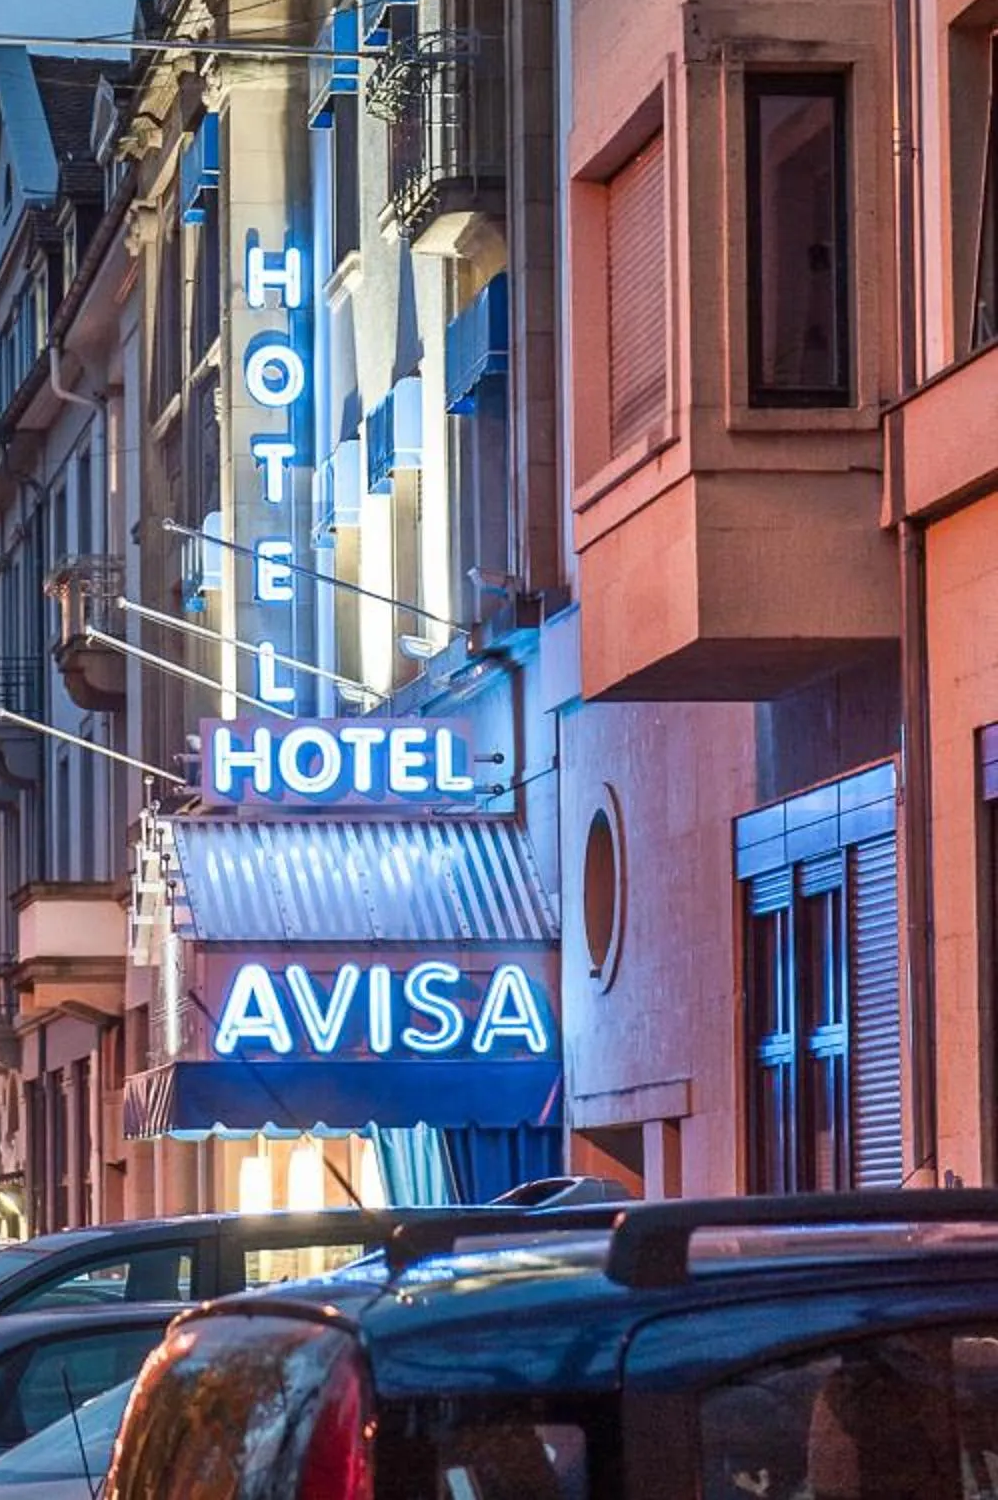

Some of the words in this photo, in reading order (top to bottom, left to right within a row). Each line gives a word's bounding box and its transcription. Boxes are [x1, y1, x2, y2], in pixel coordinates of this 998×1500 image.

[245, 246, 304, 702] HOTEL
[214, 726, 475, 793] HOTEL
[214, 961, 549, 1053] AVISA
